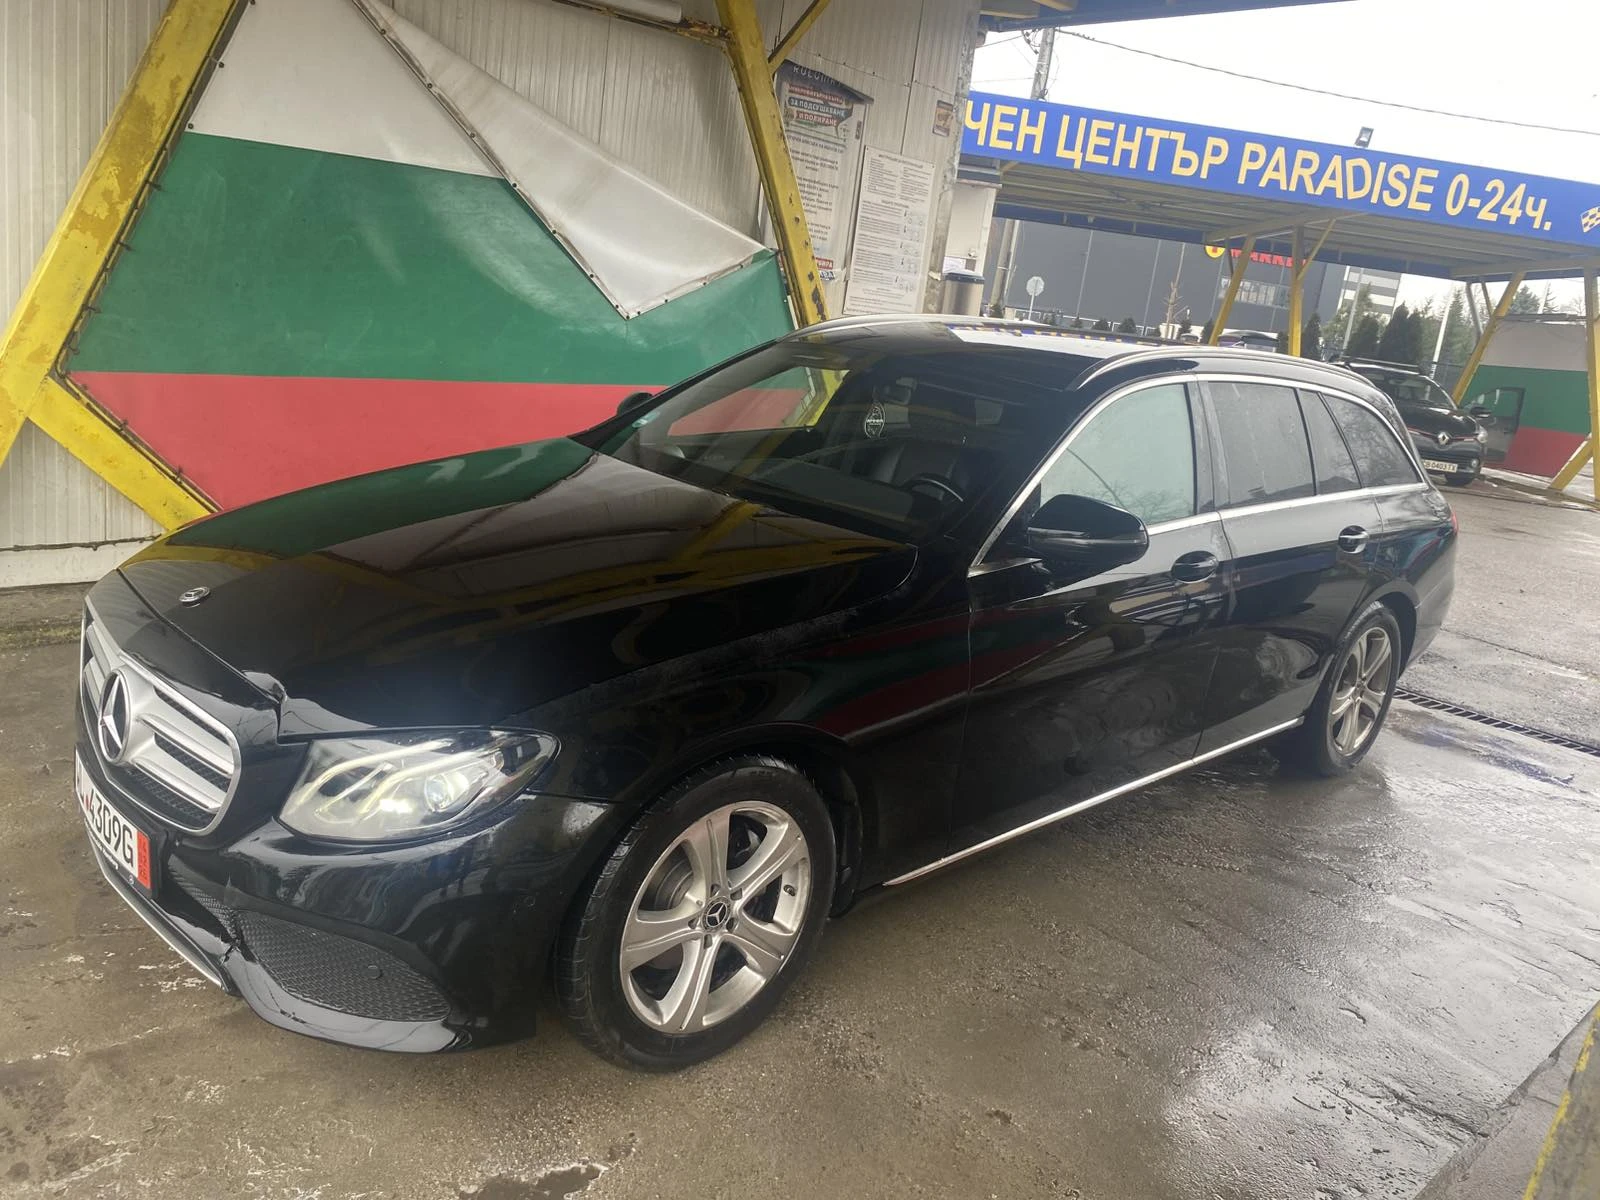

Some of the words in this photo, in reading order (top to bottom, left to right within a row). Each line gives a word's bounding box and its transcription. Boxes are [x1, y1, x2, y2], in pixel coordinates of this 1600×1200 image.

[964, 100, 1047, 154] ЧЕН
[1056, 114, 1229, 179] ЦЕНТЪР
[1237, 142, 1439, 211] PARADISE
[1445, 174, 1552, 231] 0-24ч.
